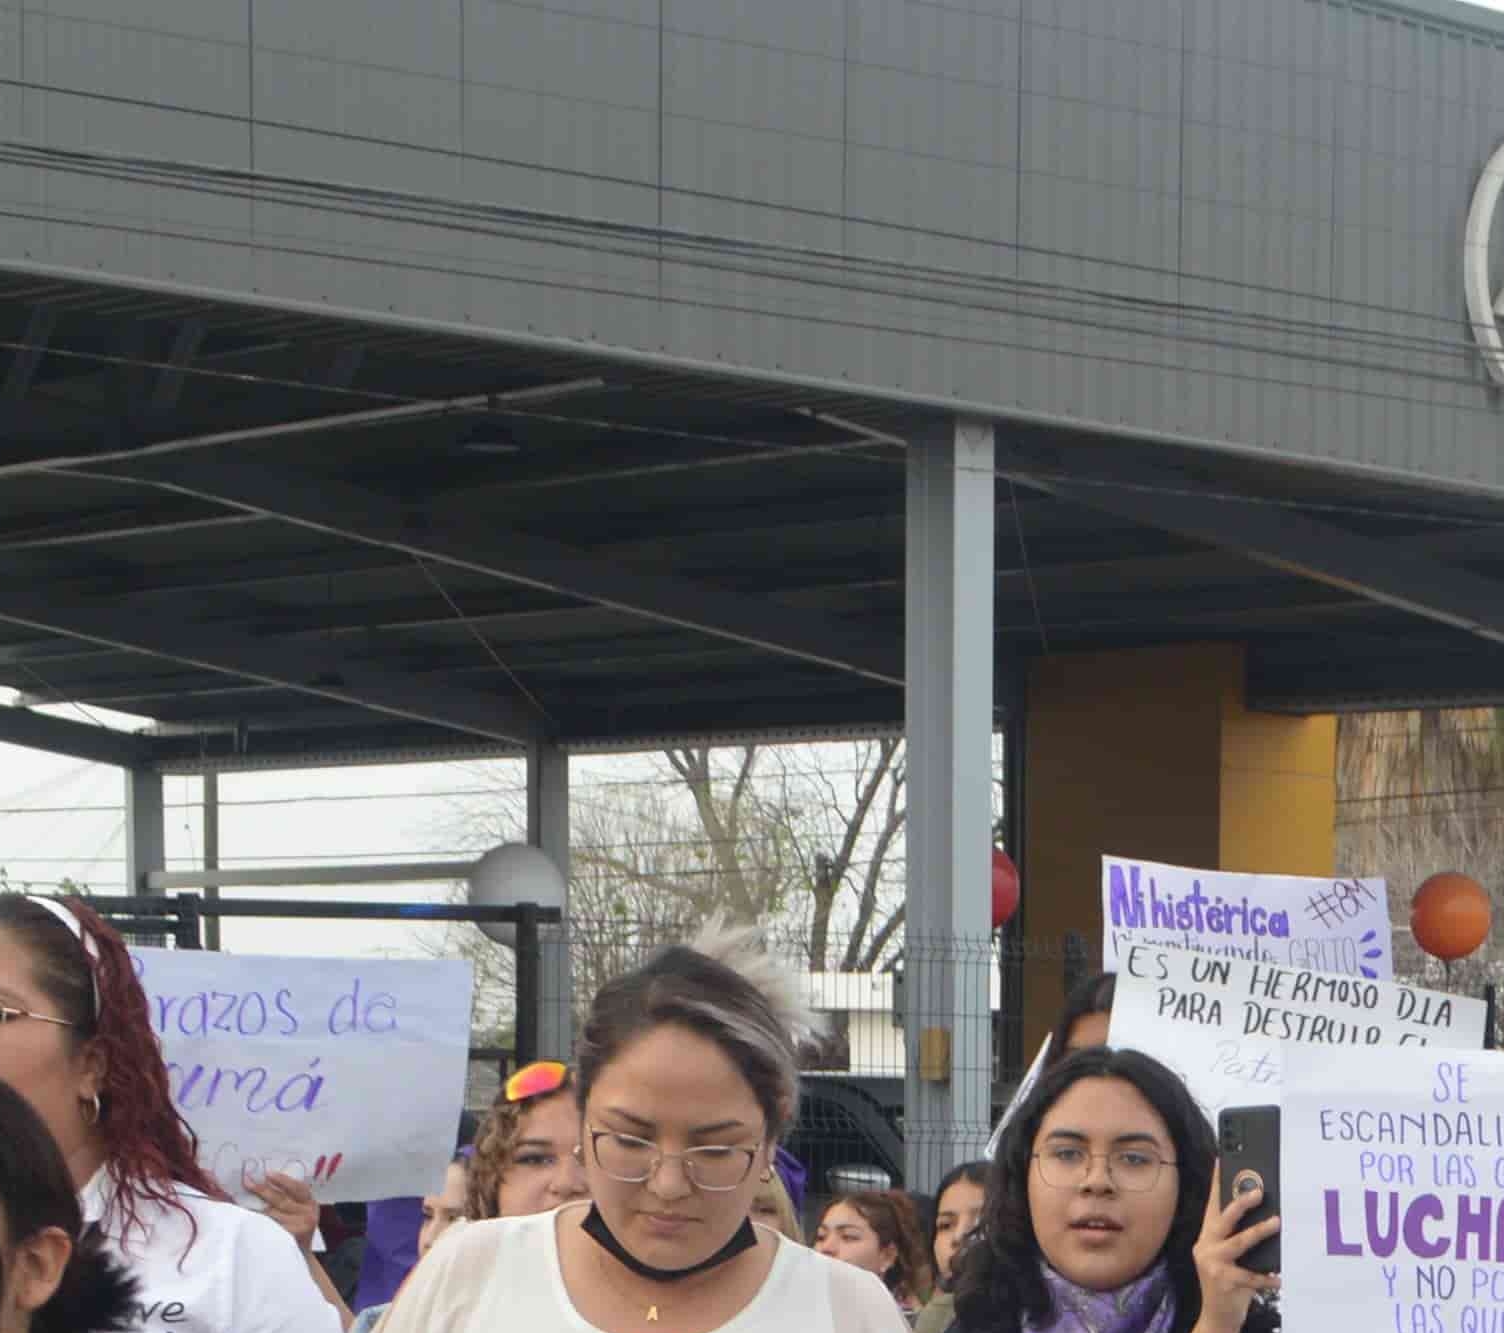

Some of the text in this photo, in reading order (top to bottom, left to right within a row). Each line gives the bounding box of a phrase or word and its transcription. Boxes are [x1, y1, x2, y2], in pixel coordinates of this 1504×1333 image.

[1109, 863, 1148, 930] Ni
[1149, 877, 1291, 938] histérica
[328, 978, 398, 1034] de
[1127, 945, 1169, 981] ES
[1191, 957, 1231, 986] UN
[1249, 964, 1379, 1011] HERMOSO
[1397, 988, 1453, 1028] DIA
[1157, 989, 1222, 1028] PARA
[1432, 1062, 1471, 1105] SE
[1359, 1150, 1414, 1186] POR
[1432, 1154, 1479, 1188] LAS
[1382, 1264, 1398, 1296] Y
[1416, 1265, 1457, 1301] NO
